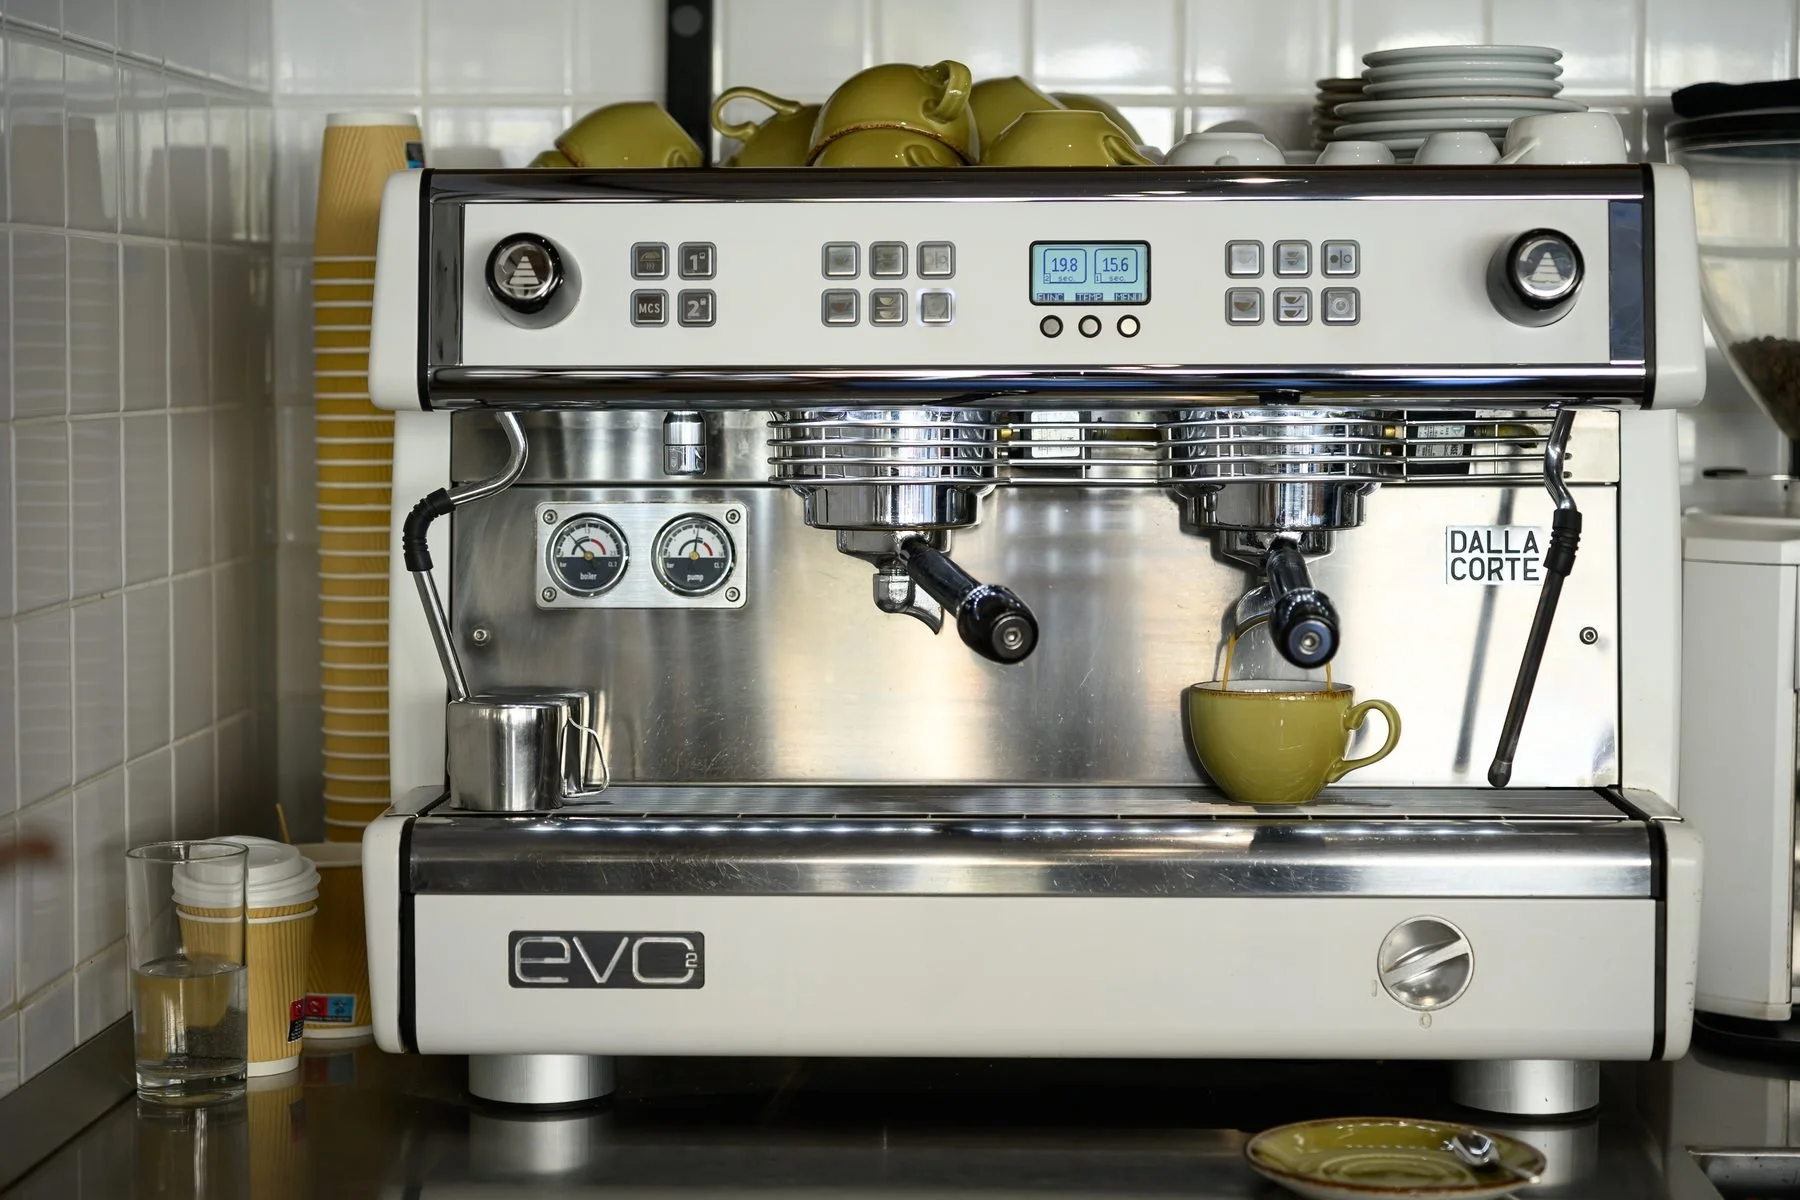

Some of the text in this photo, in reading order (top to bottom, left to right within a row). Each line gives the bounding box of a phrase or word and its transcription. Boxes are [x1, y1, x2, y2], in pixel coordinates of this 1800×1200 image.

[1051, 257, 1078, 272] 19.8
[1103, 257, 1129, 272] 15.6
[1038, 293, 1064, 301] FUNC
[1077, 293, 1103, 301] TEMP
[1116, 293, 1142, 301] MENU
[639, 303, 660, 314] MCS
[1451, 530, 1539, 553] DALLA
[1451, 557, 1539, 581] CORTE
[580, 572, 597, 580] boiler
[687, 574, 704, 583] pump
